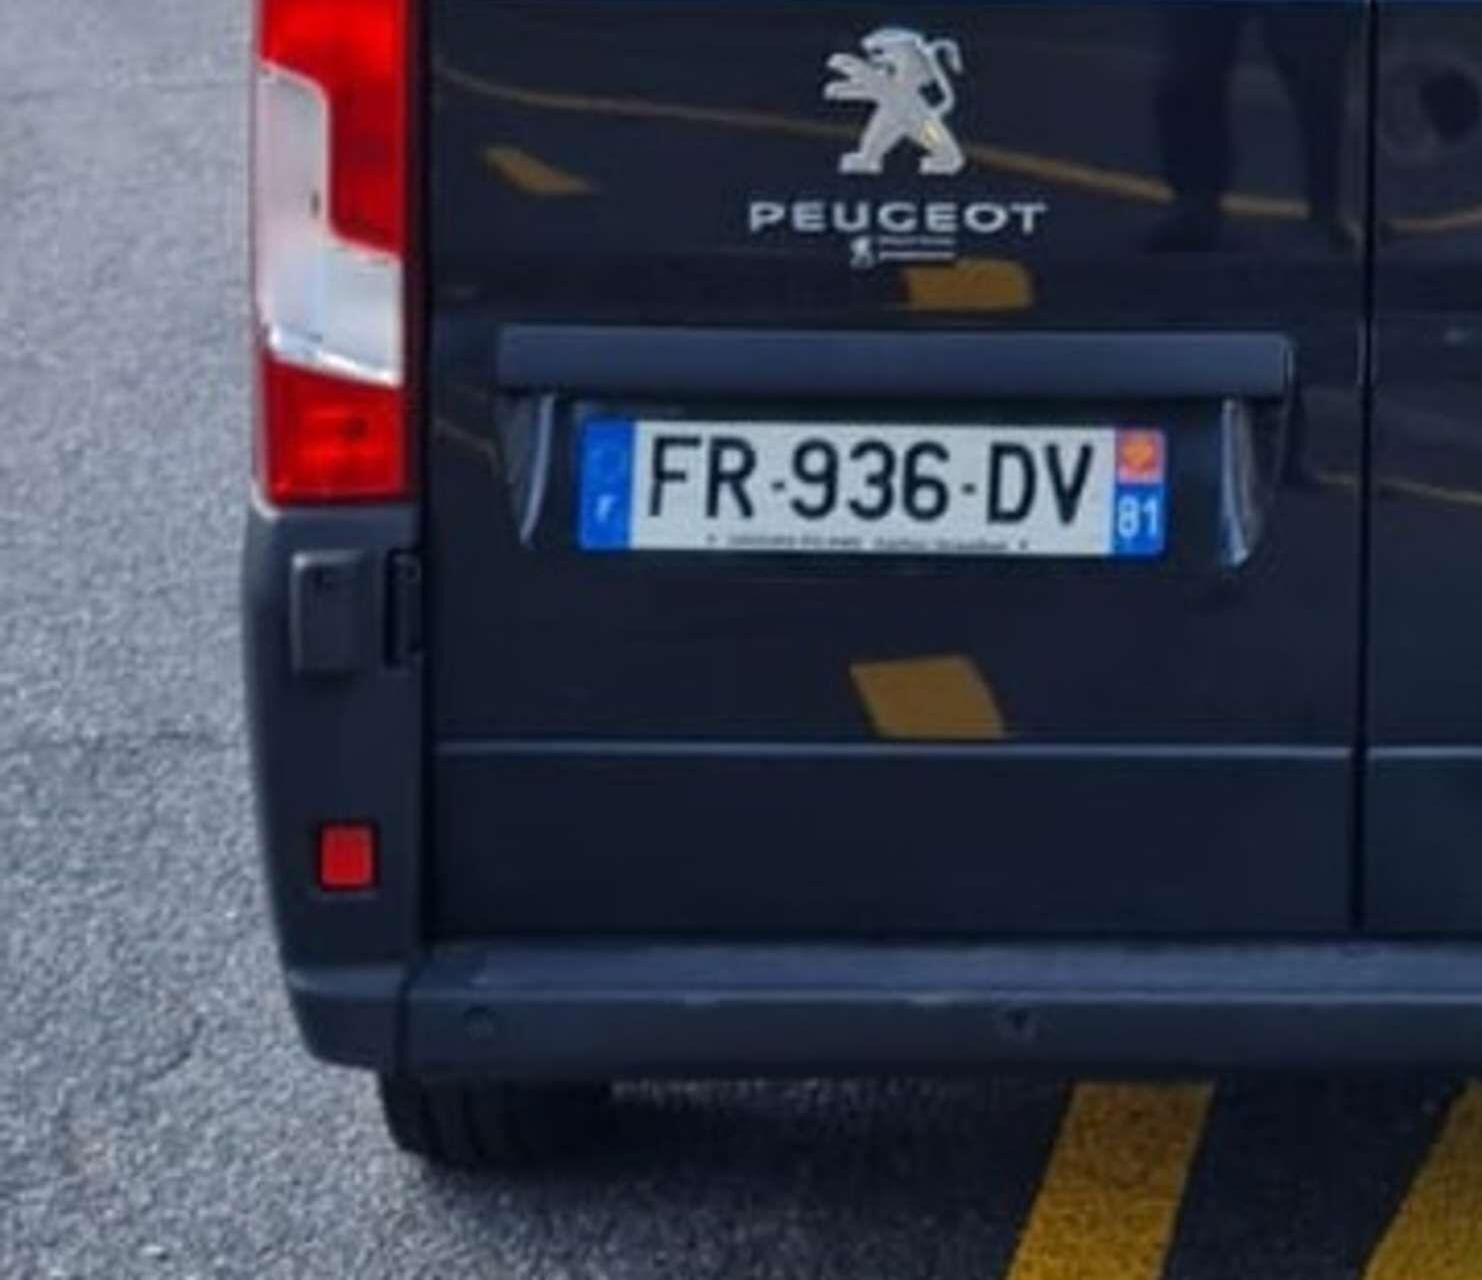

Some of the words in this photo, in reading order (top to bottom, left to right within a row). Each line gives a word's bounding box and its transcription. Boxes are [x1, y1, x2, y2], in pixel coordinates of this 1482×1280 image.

[749, 201, 1049, 234] PEUGEOT
[648, 434, 1095, 527] FR-936-DV
[1117, 495, 1161, 538] 81
